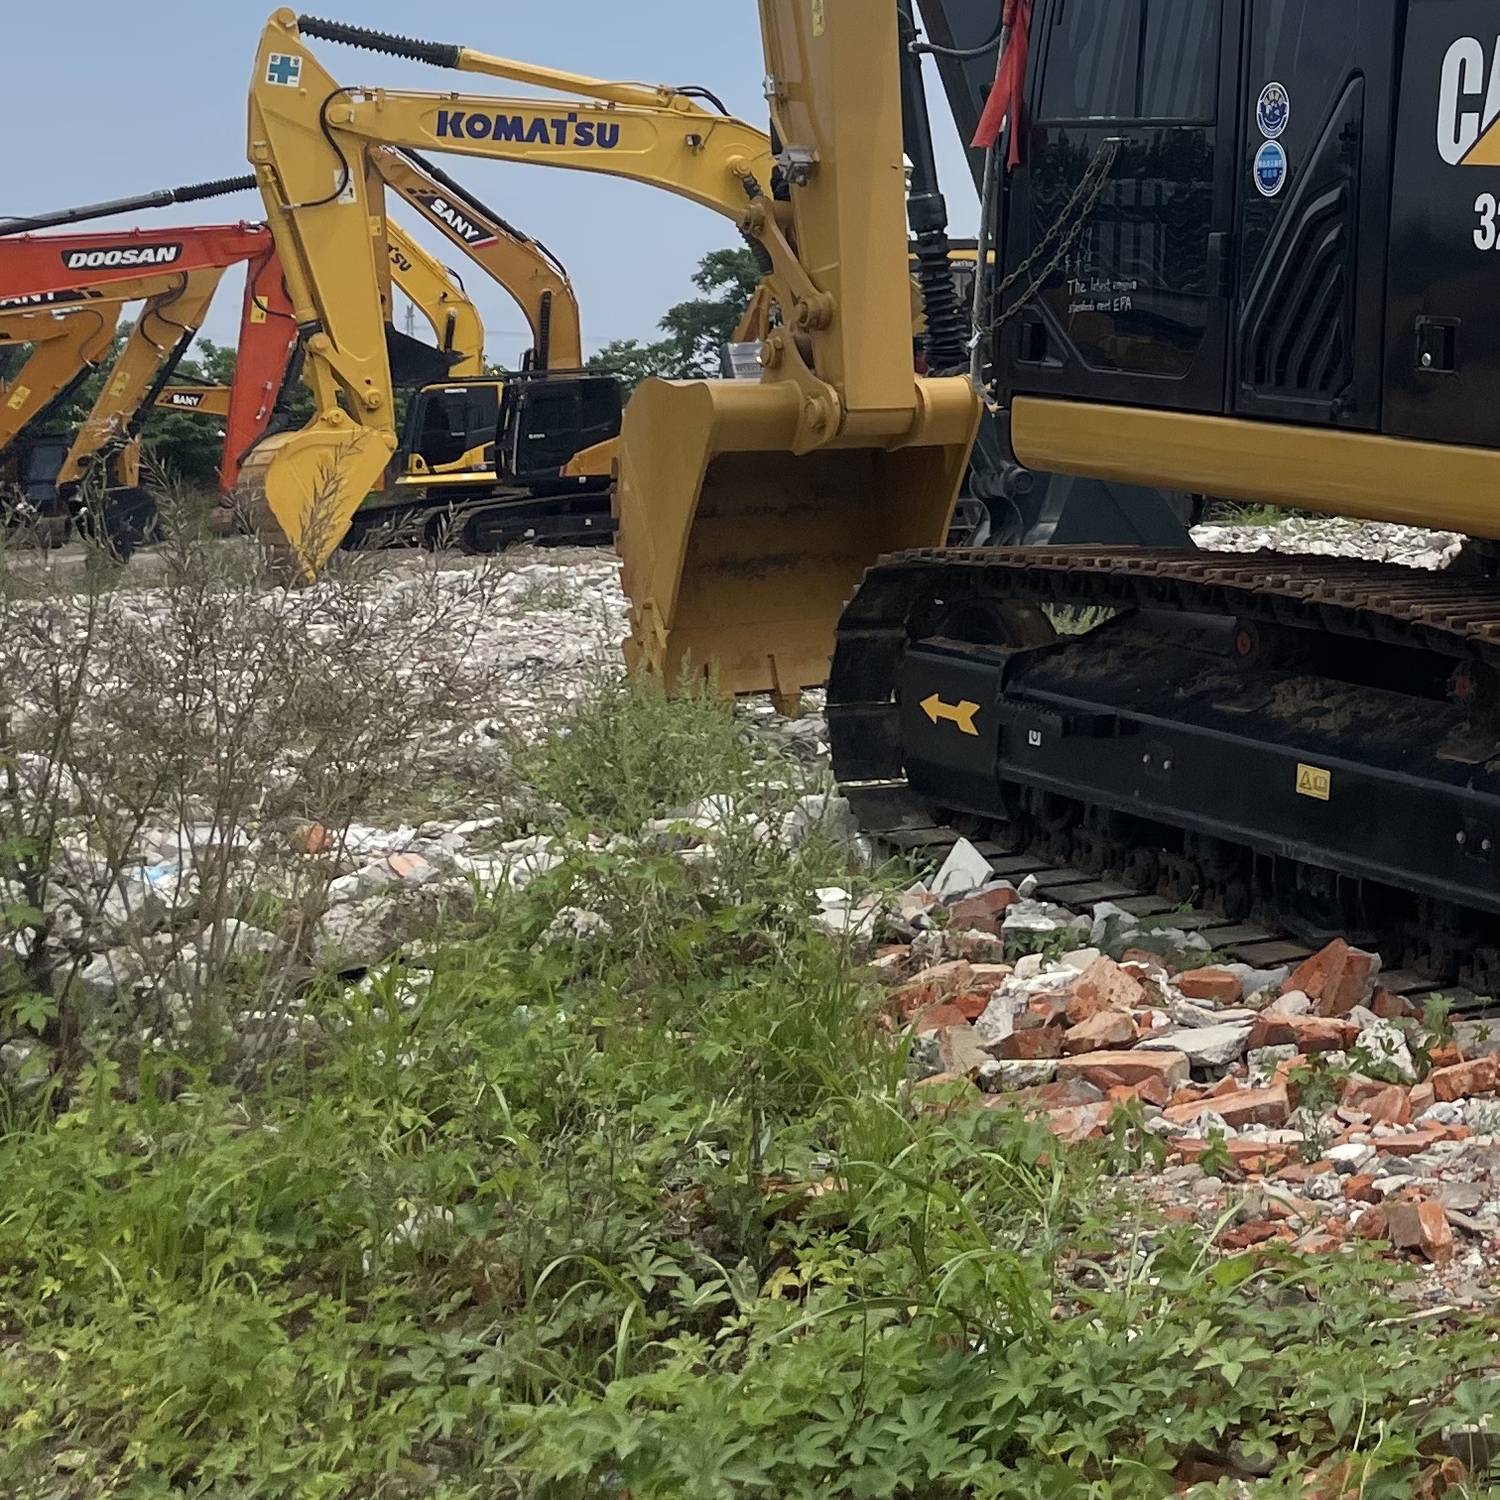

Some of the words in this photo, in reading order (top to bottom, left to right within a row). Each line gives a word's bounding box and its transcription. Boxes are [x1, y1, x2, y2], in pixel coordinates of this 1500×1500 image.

[436, 110, 620, 148] KOMATSU
[430, 198, 479, 239] SANY
[68, 247, 177, 268] DOOSAN
